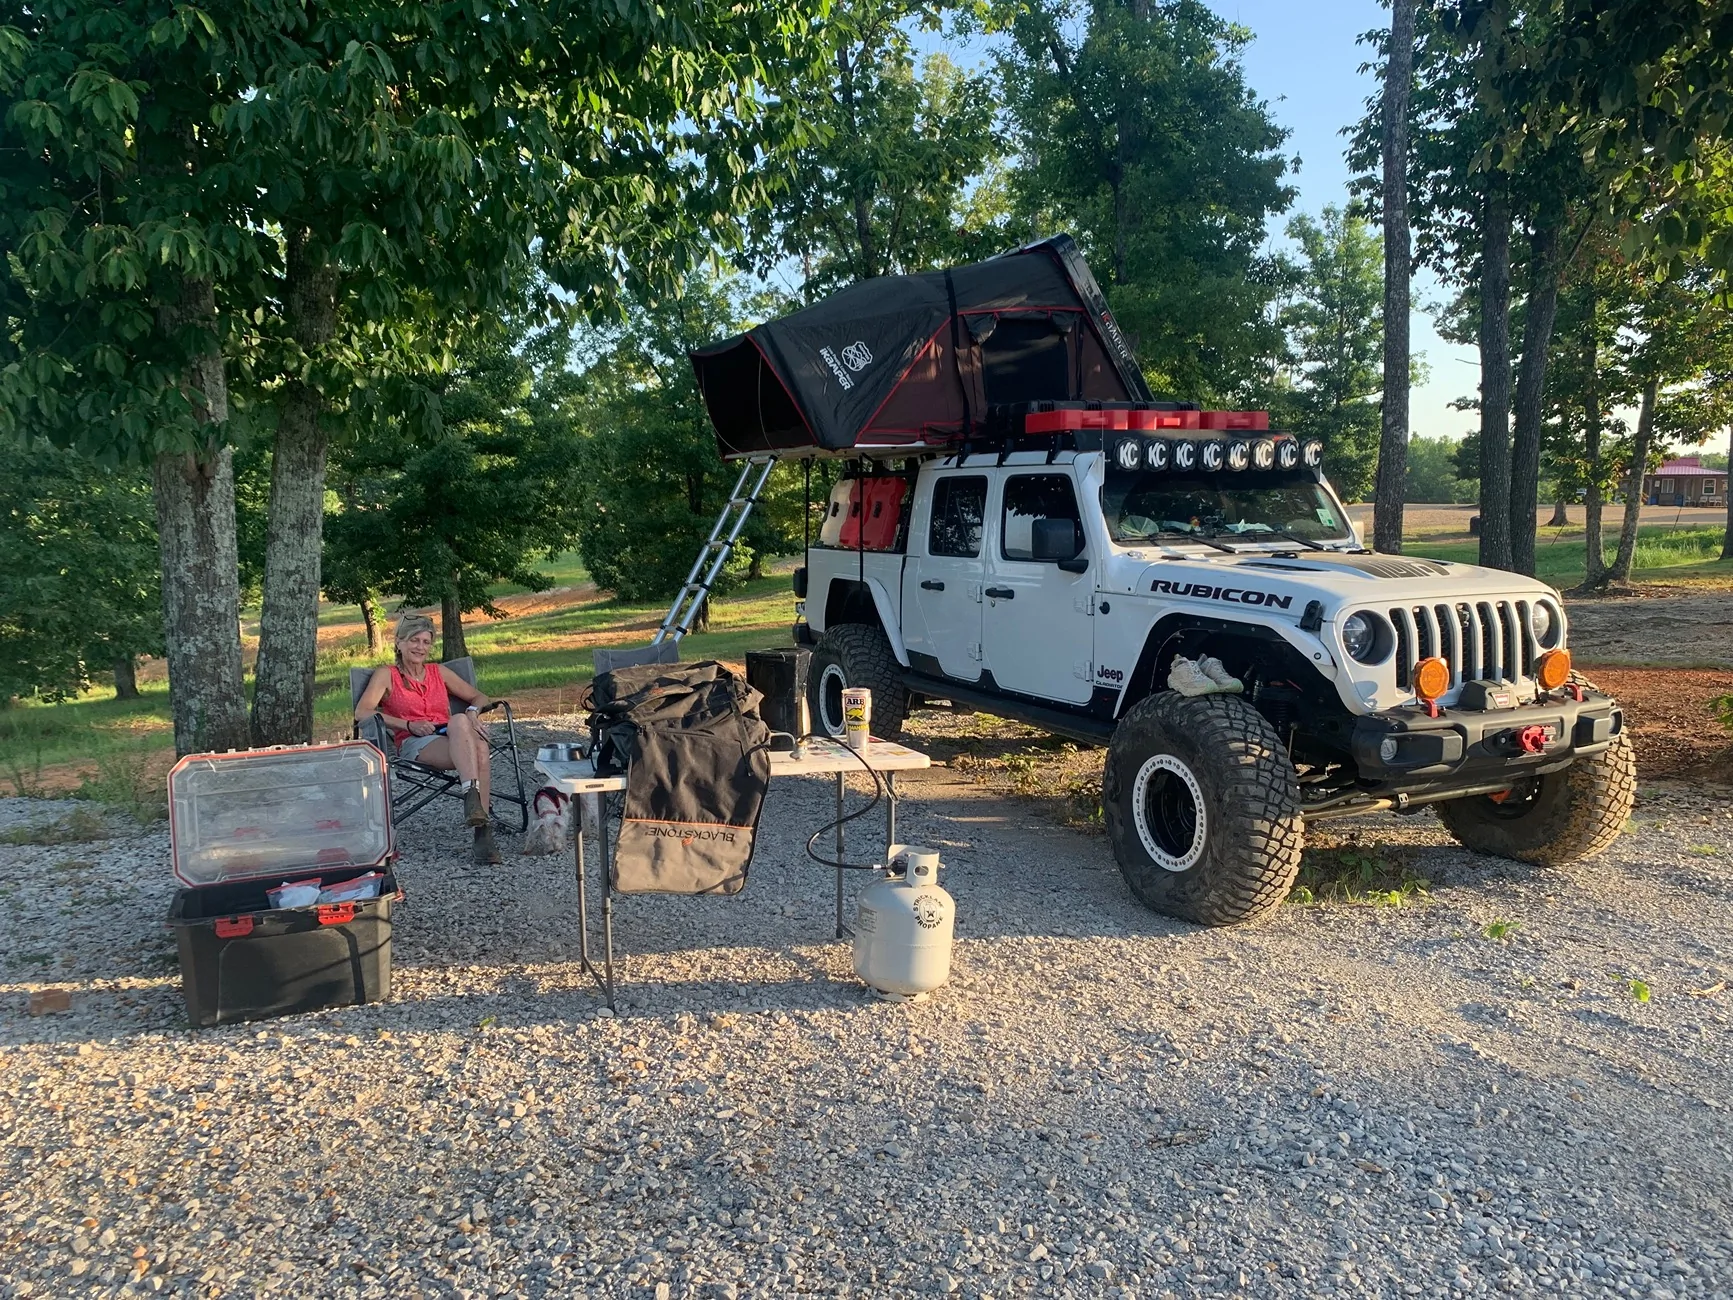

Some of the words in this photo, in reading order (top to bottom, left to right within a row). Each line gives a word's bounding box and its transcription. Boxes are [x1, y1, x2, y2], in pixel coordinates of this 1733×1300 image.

[1119, 441, 1138, 469] KC
[1148, 442, 1166, 467] KC
[1176, 441, 1194, 467] KC
[1203, 442, 1221, 468] KC
[1229, 442, 1247, 468] KC
[1255, 442, 1272, 468] KC
[1281, 443, 1297, 467] KC
[1305, 442, 1321, 467] KC
[1150, 579, 1293, 609] RUBICON
[1097, 664, 1124, 683] Jeep
[648, 826, 736, 843] BLACKSTONE
[914, 915, 944, 930] PROPANE
